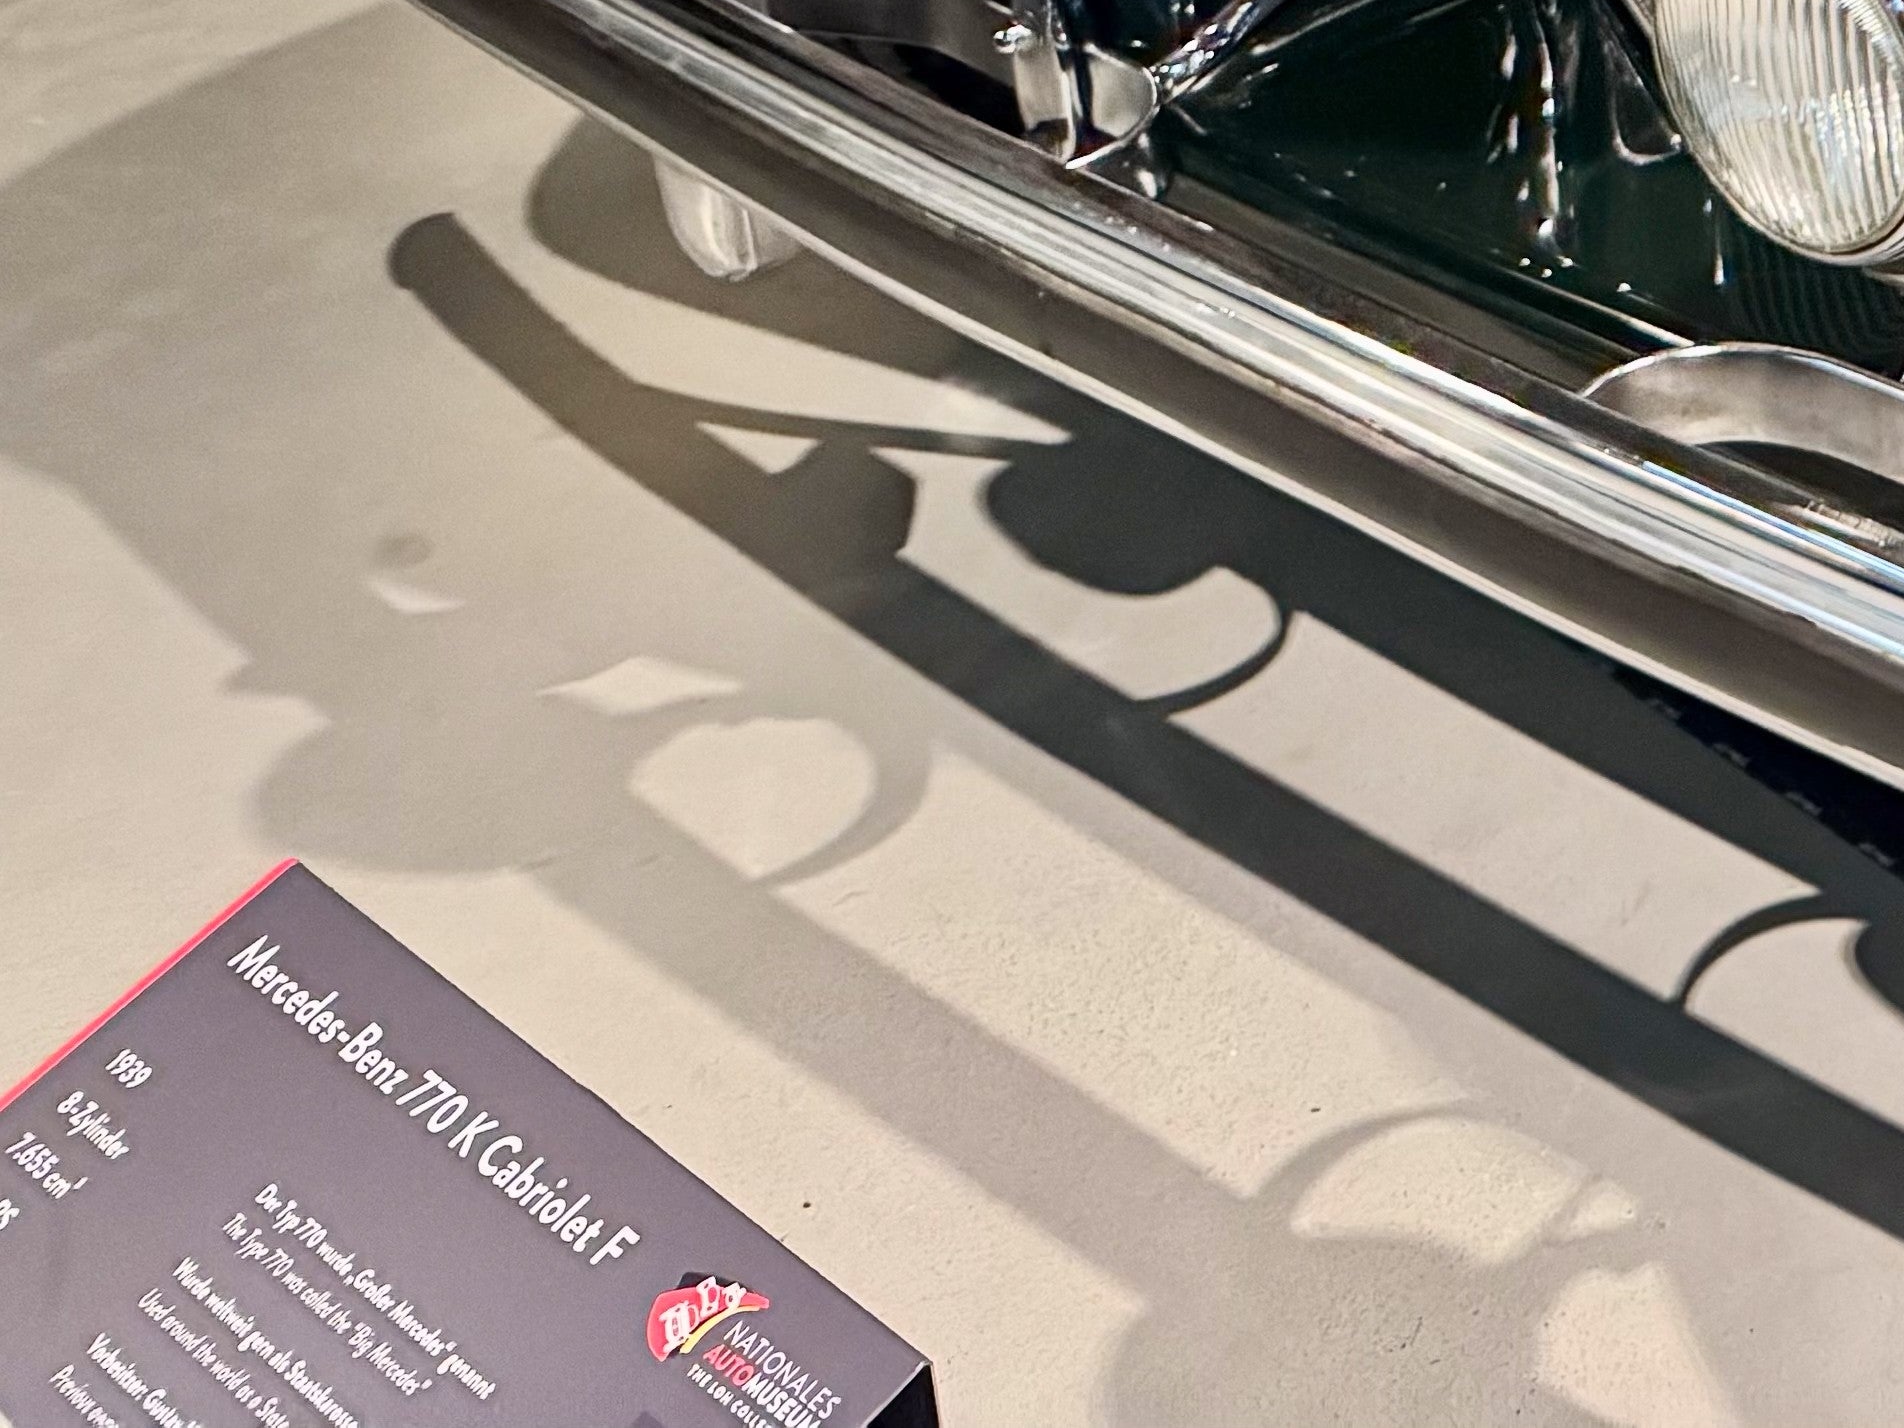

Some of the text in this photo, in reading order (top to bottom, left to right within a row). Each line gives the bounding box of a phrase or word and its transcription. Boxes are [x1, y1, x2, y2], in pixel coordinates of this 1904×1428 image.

[106, 1049, 152, 1087] 1939
[229, 936, 640, 1265] Mercedes-Benz 770 K Cabriolet F
[58, 1091, 129, 1159] 8-Zylinder
[6, 1132, 59, 1178] 7.655
[222, 1212, 247, 1240] The
[234, 1228, 269, 1259] Type
[272, 1199, 301, 1233] Typ
[293, 1217, 327, 1248] 770
[260, 1248, 294, 1276] 770
[280, 1271, 308, 1294] was
[173, 1257, 213, 1300] Wurde
[205, 1293, 255, 1337] weltweit
[237, 1331, 275, 1359] gern
[268, 1349, 295, 1373] als
[300, 1287, 342, 1318] called
[327, 1309, 352, 1334] the
[138, 1288, 176, 1321] Used
[160, 1316, 209, 1351] around
[192, 1336, 217, 1366] the
[209, 1360, 251, 1390] world
[235, 1382, 255, 1402] as
[687, 1363, 712, 1387] THE
[707, 1381, 734, 1405] LOH
[703, 1345, 820, 1428] AUTOMUSEUM
[724, 1321, 841, 1418] NATIONALES
